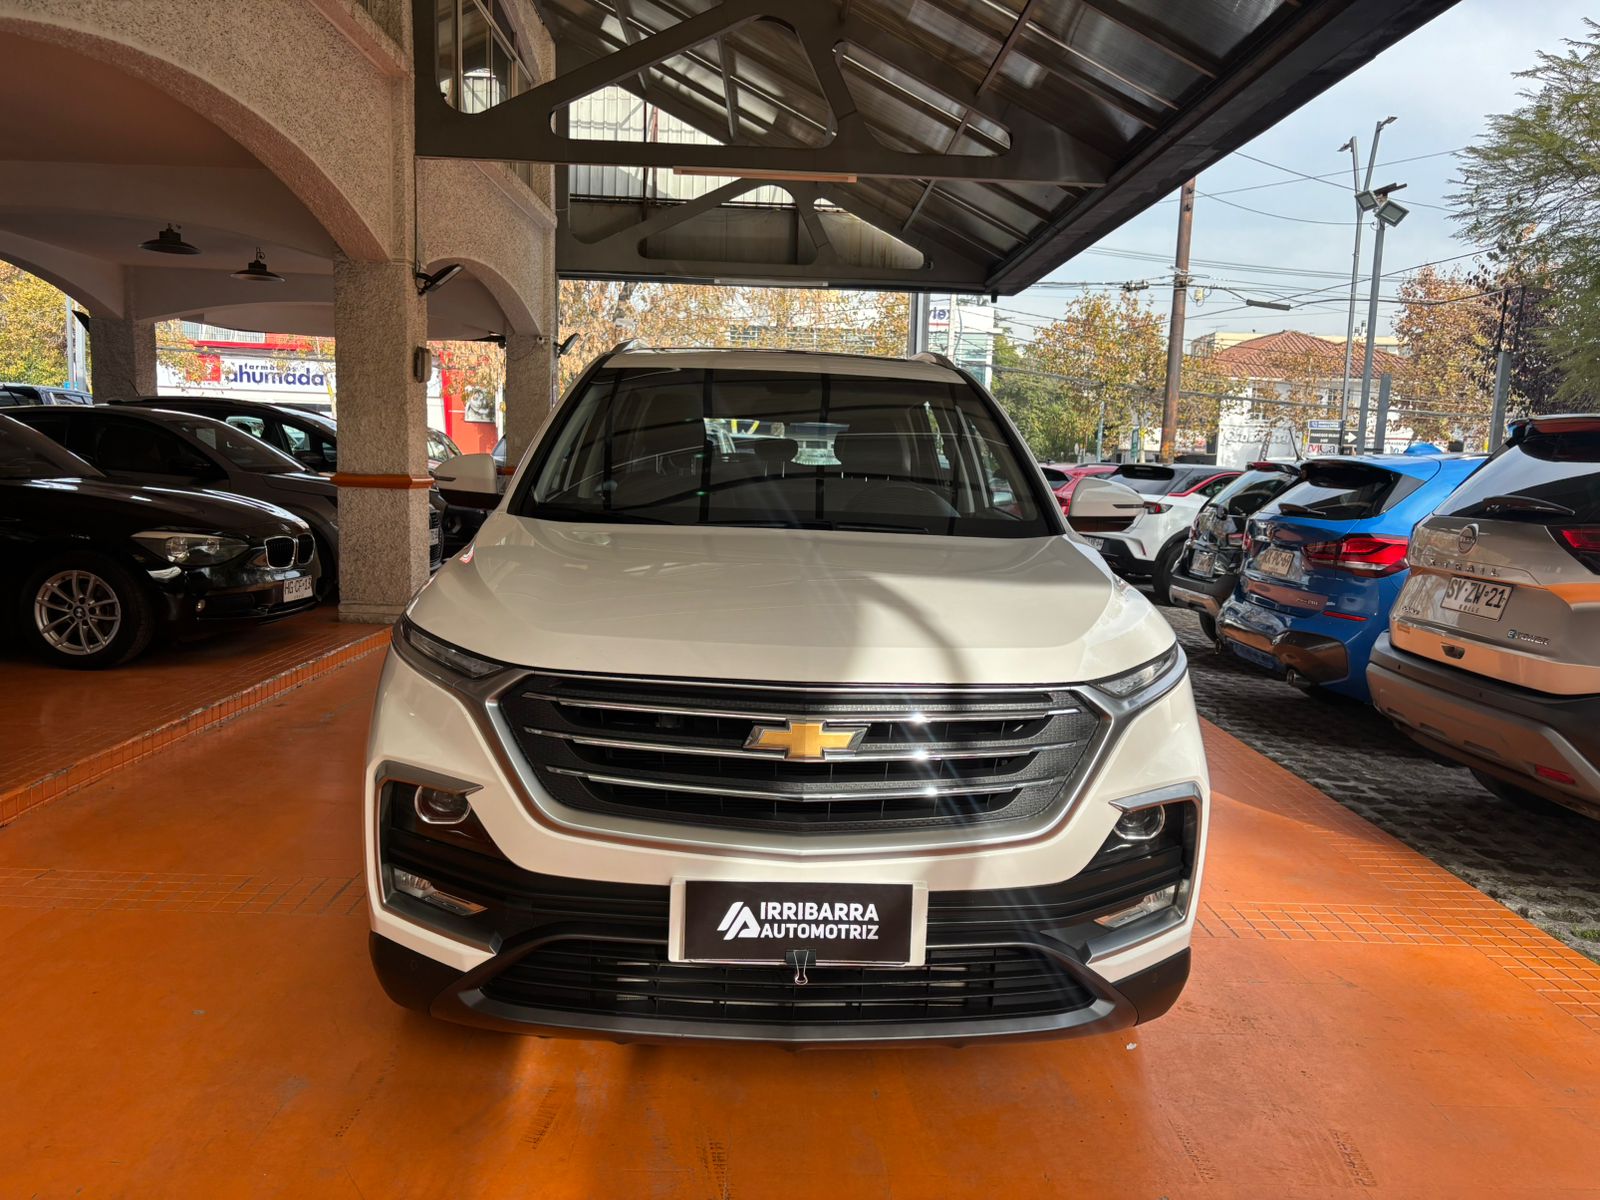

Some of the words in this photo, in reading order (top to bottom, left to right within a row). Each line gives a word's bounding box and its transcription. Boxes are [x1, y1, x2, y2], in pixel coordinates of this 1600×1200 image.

[226, 364, 325, 386] ahumada
[760, 901, 879, 921] IRRIBARRA
[760, 923, 879, 940] AUTOMOTRIZ
